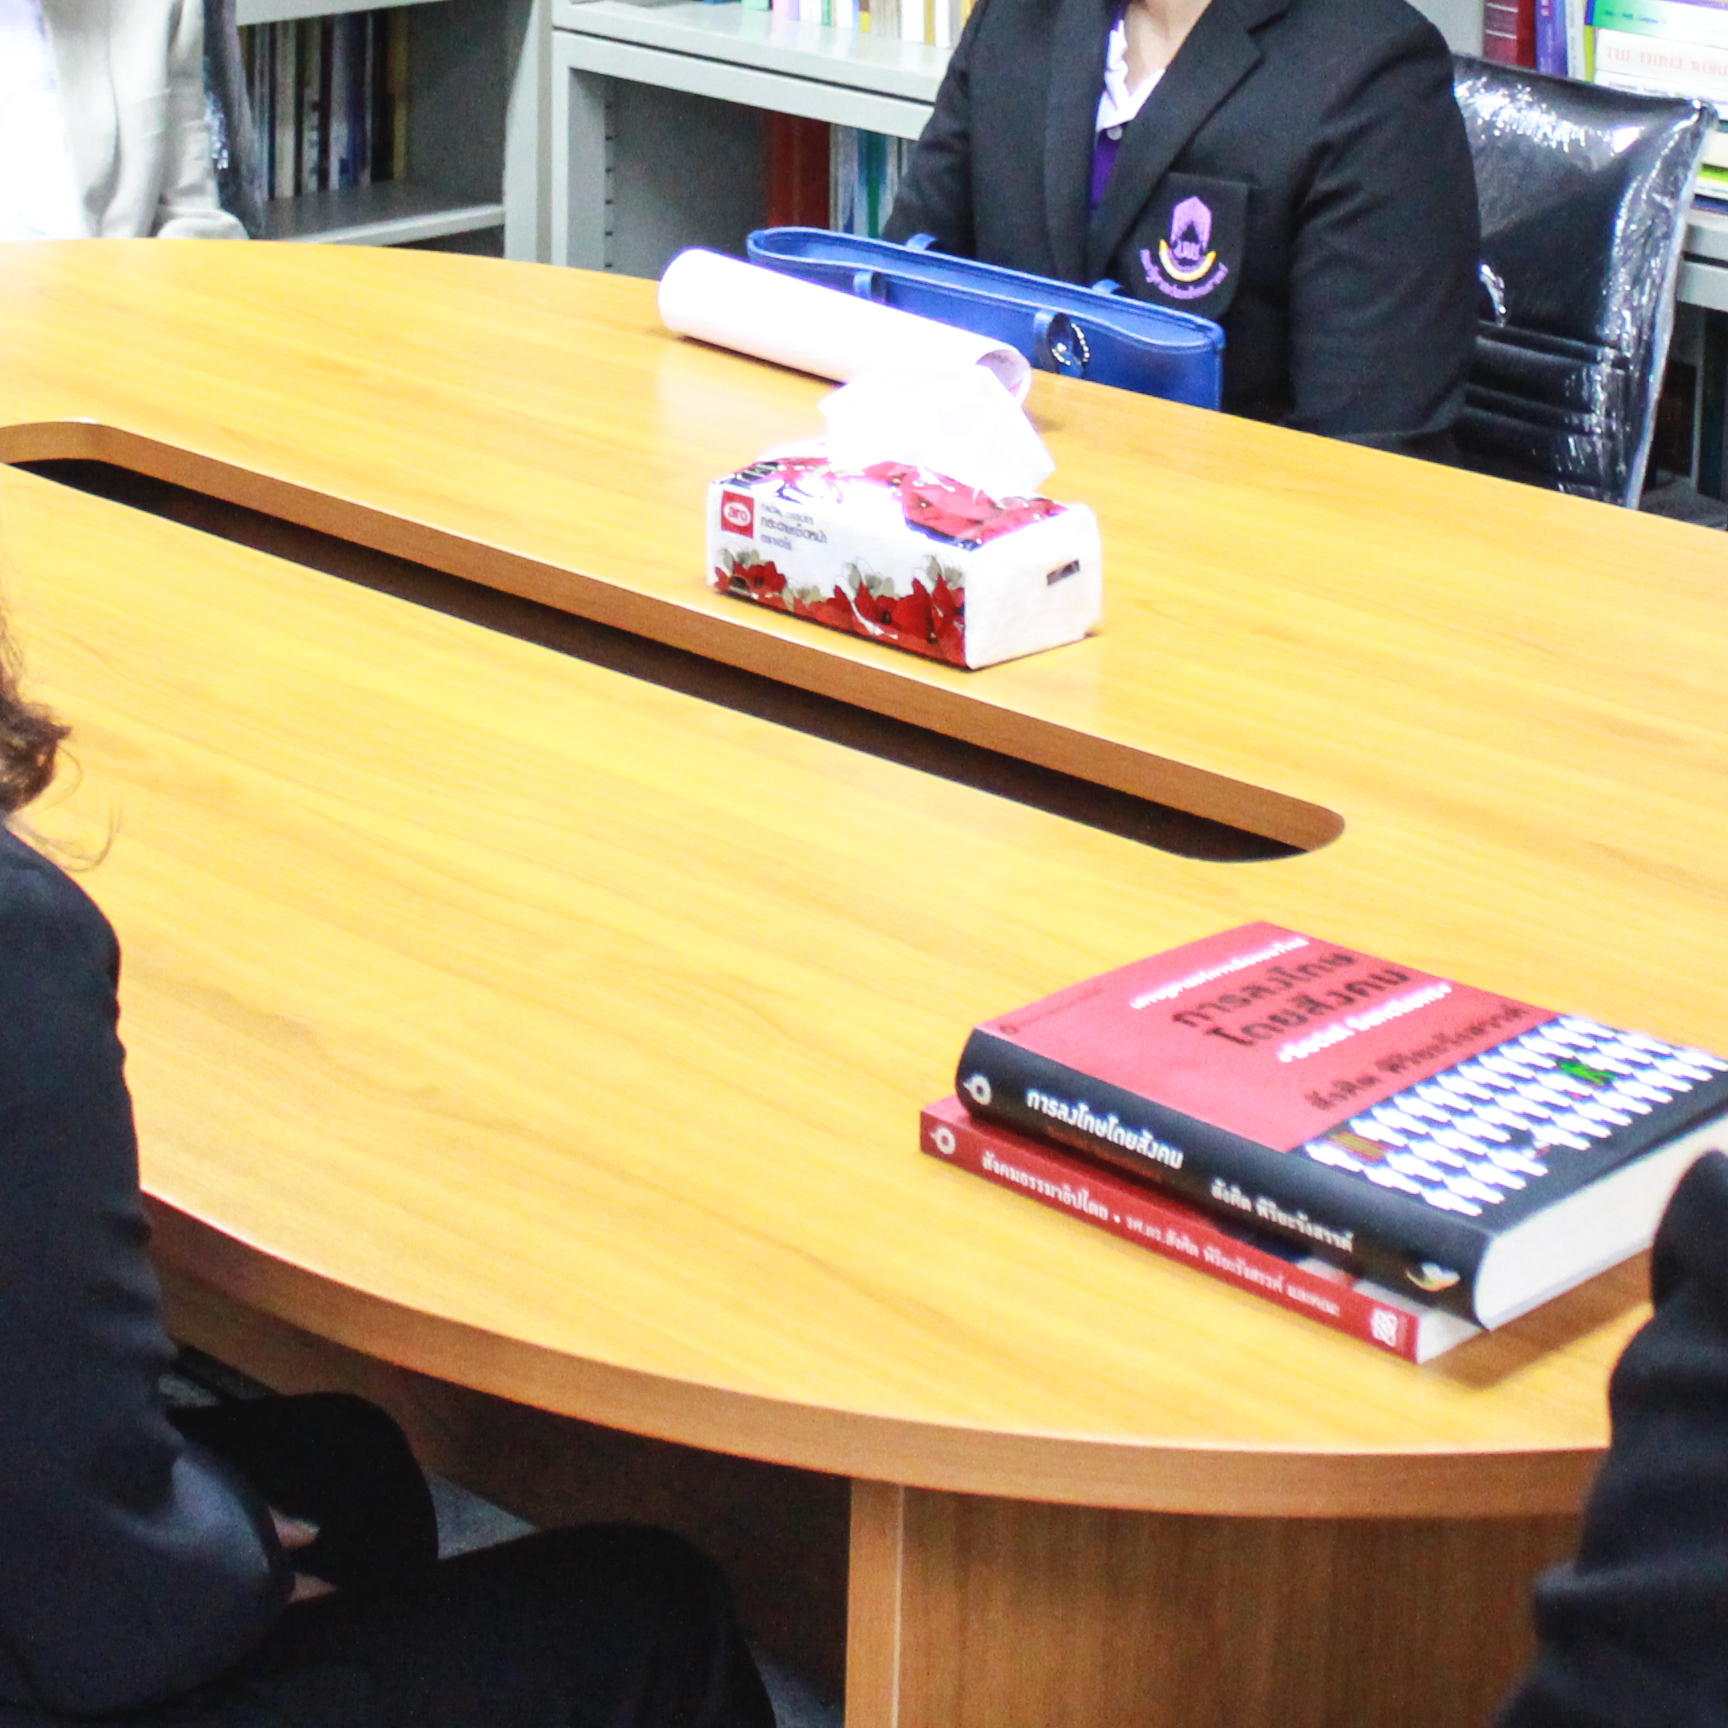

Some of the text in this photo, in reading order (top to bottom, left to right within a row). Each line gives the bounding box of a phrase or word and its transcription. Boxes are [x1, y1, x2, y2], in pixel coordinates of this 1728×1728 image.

[1172, 949, 1356, 1029] การลงโทษ
[1204, 964, 1411, 1048] โดยสังคม
[1027, 1088, 1184, 1170] การลงโทษโดยสังคม
